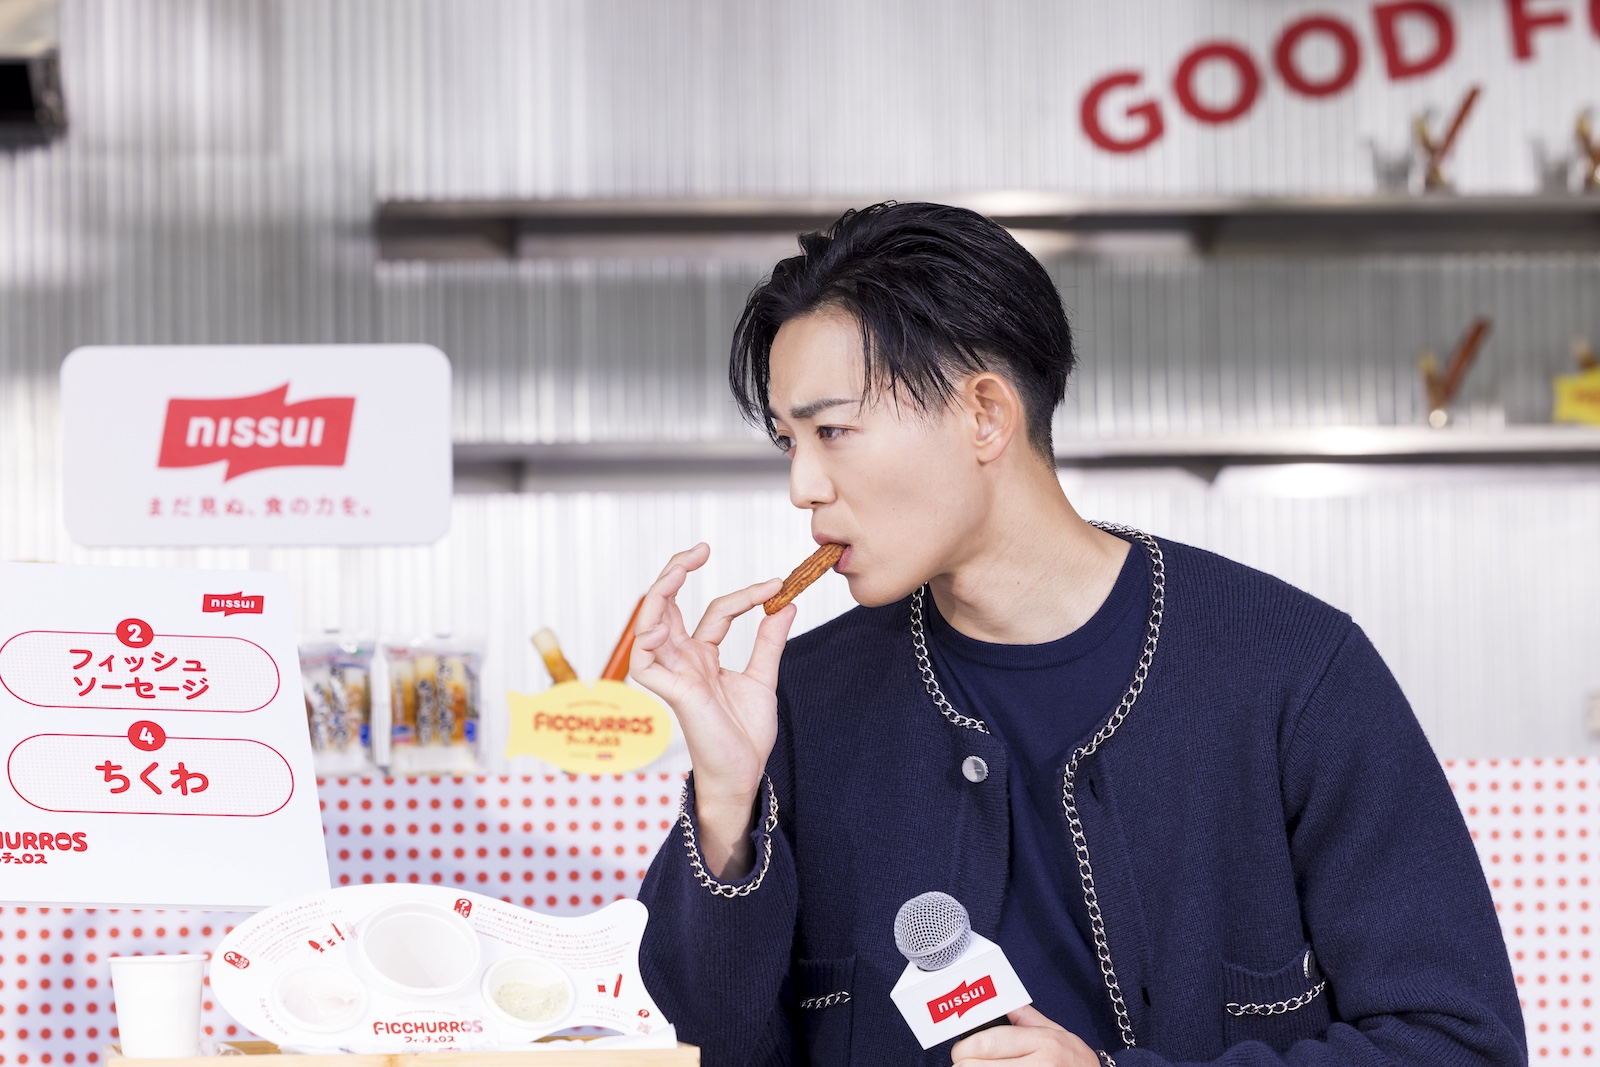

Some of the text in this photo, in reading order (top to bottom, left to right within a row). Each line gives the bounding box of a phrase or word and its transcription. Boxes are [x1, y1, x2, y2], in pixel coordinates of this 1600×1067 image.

[1079, 0, 1600, 155] GOOD F
[147, 496, 373, 518] まだ見ぬ、食の力を。
[126, 623, 144, 643] 2
[69, 648, 207, 673] フィッシュ
[73, 675, 210, 700] ソーセージ
[533, 711, 655, 735] FICCHURROS
[138, 726, 155, 745] 4
[94, 759, 210, 796] ちくわ
[0, 831, 88, 852] URROS
[937, 985, 985, 1014] nissui
[373, 1019, 484, 1036] FICCHURROS
